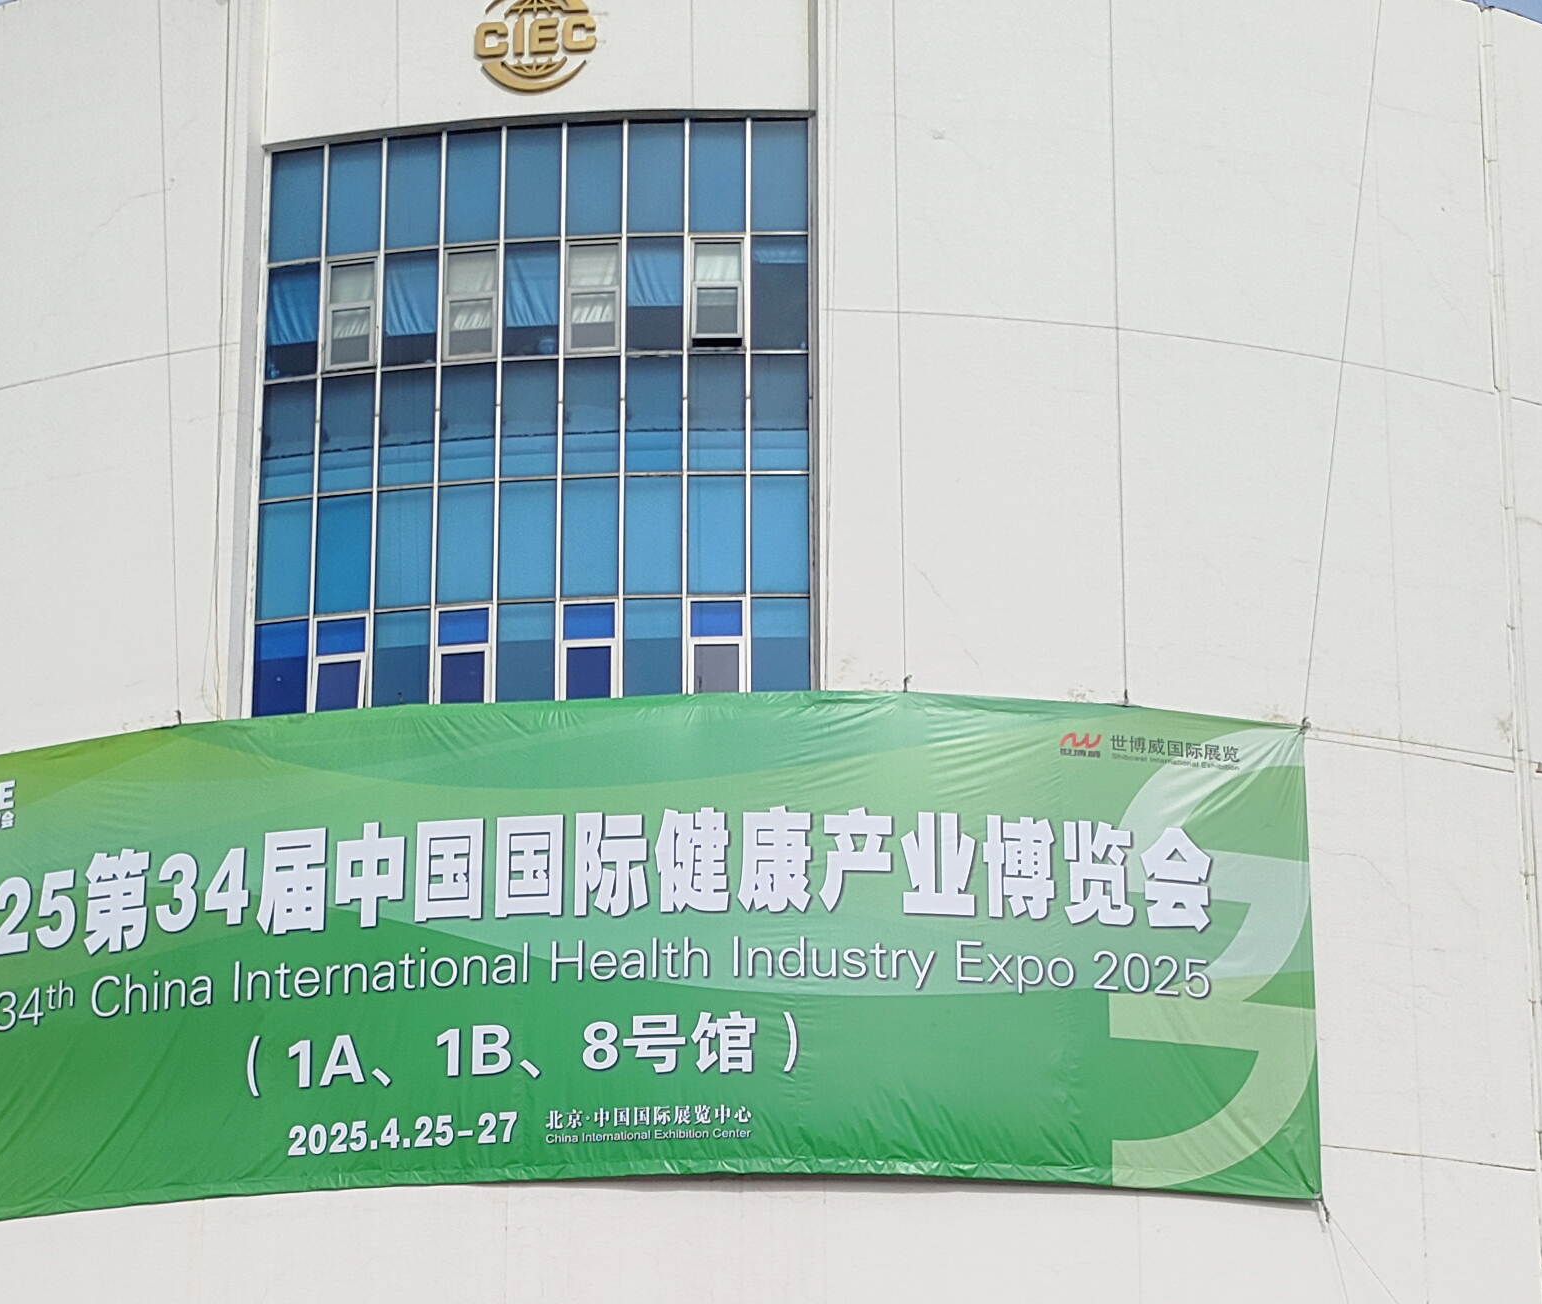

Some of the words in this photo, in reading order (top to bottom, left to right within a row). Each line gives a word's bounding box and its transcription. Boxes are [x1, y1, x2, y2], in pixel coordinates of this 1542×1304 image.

[474, 15, 597, 58] CIEC
[1110, 734, 1241, 763] 世博威国际展览
[91, 969, 213, 1019] China
[234, 942, 529, 1002] International
[551, 937, 709, 984] Health
[732, 936, 936, 990] Industry
[957, 941, 1075, 994] Expo
[1094, 950, 1211, 999] 2025
[288, 1111, 518, 1157] 2025.4.25-27
[546, 1133, 578, 1144] China
[582, 1130, 651, 1143] International
[654, 1129, 709, 1140] Exhibition
[712, 1127, 751, 1139] Center
